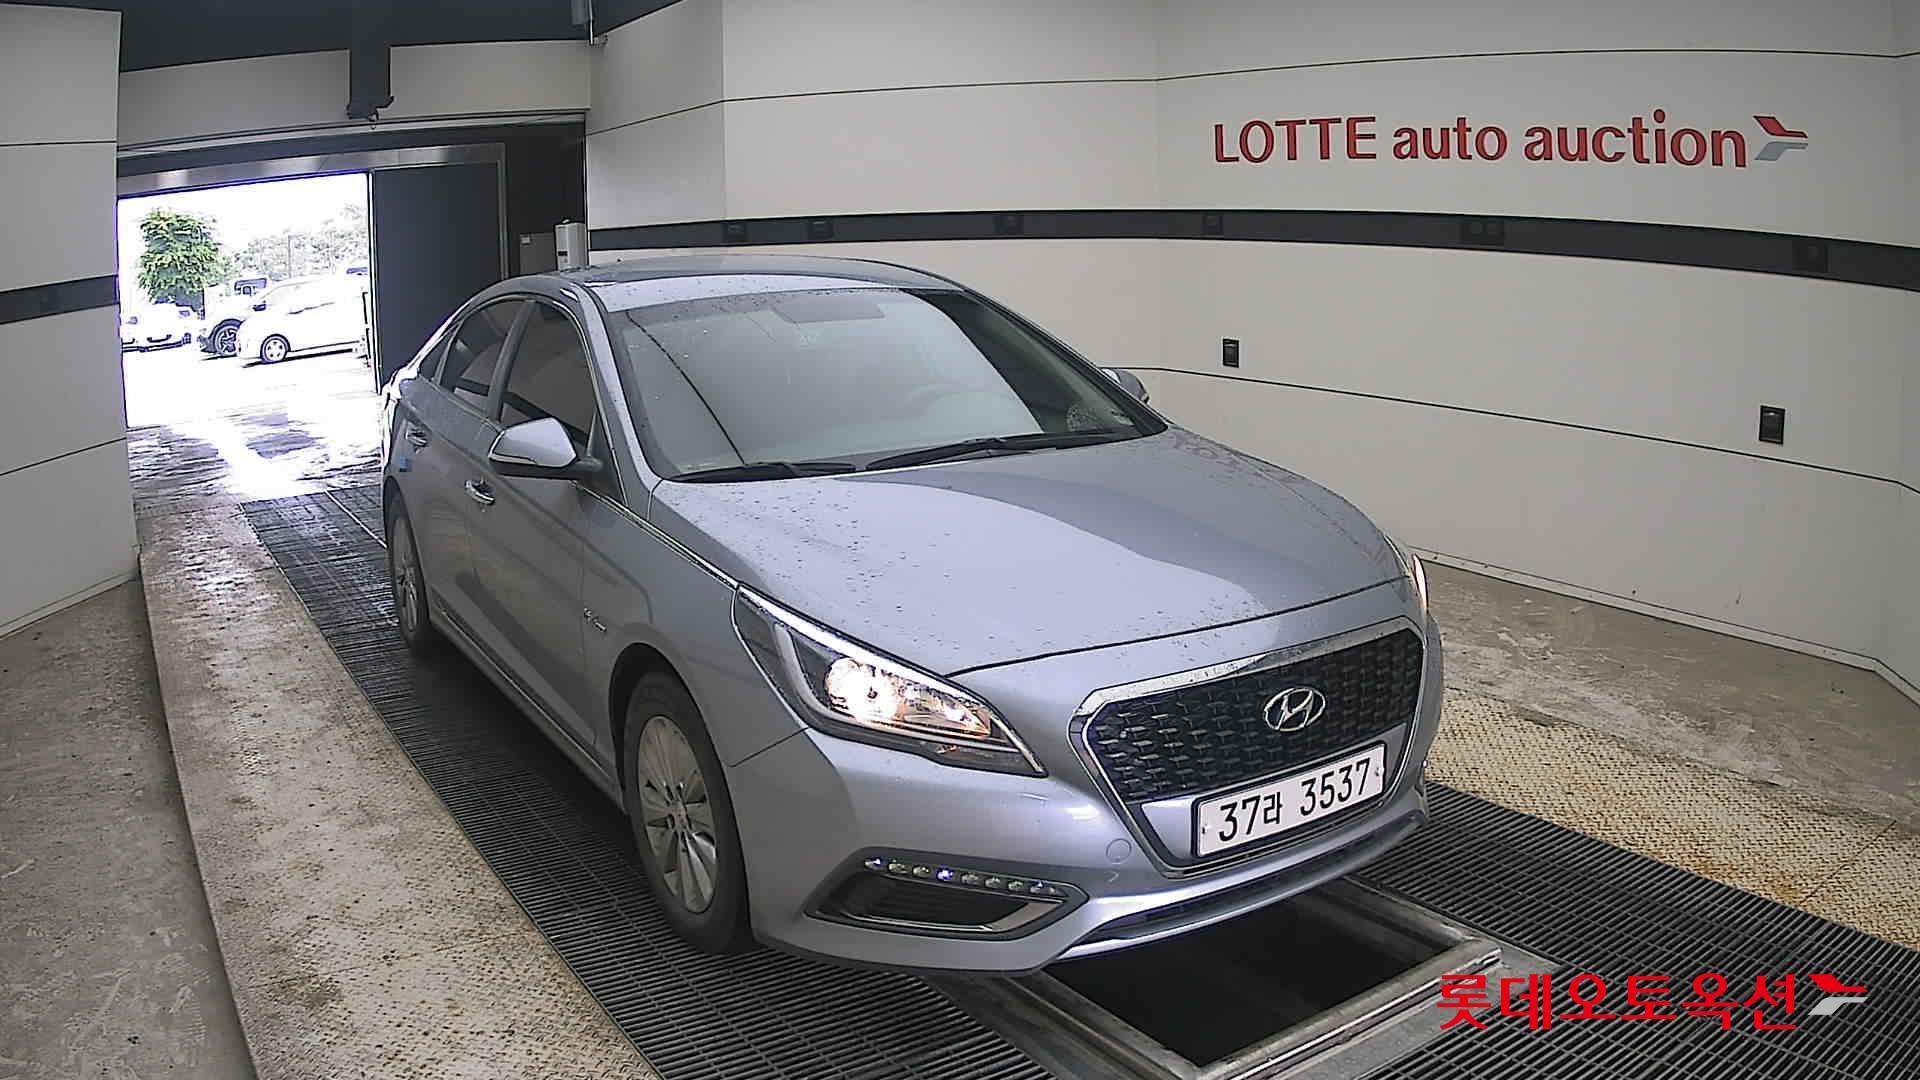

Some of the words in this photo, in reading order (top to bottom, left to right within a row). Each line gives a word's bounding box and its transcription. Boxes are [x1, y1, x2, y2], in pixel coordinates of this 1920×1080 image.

[1213, 116, 1377, 163] LOTTE
[1393, 117, 1508, 161] auto
[1523, 109, 1748, 168] auction
[1218, 791, 1283, 842] 37라
[1300, 757, 1371, 817] 3537
